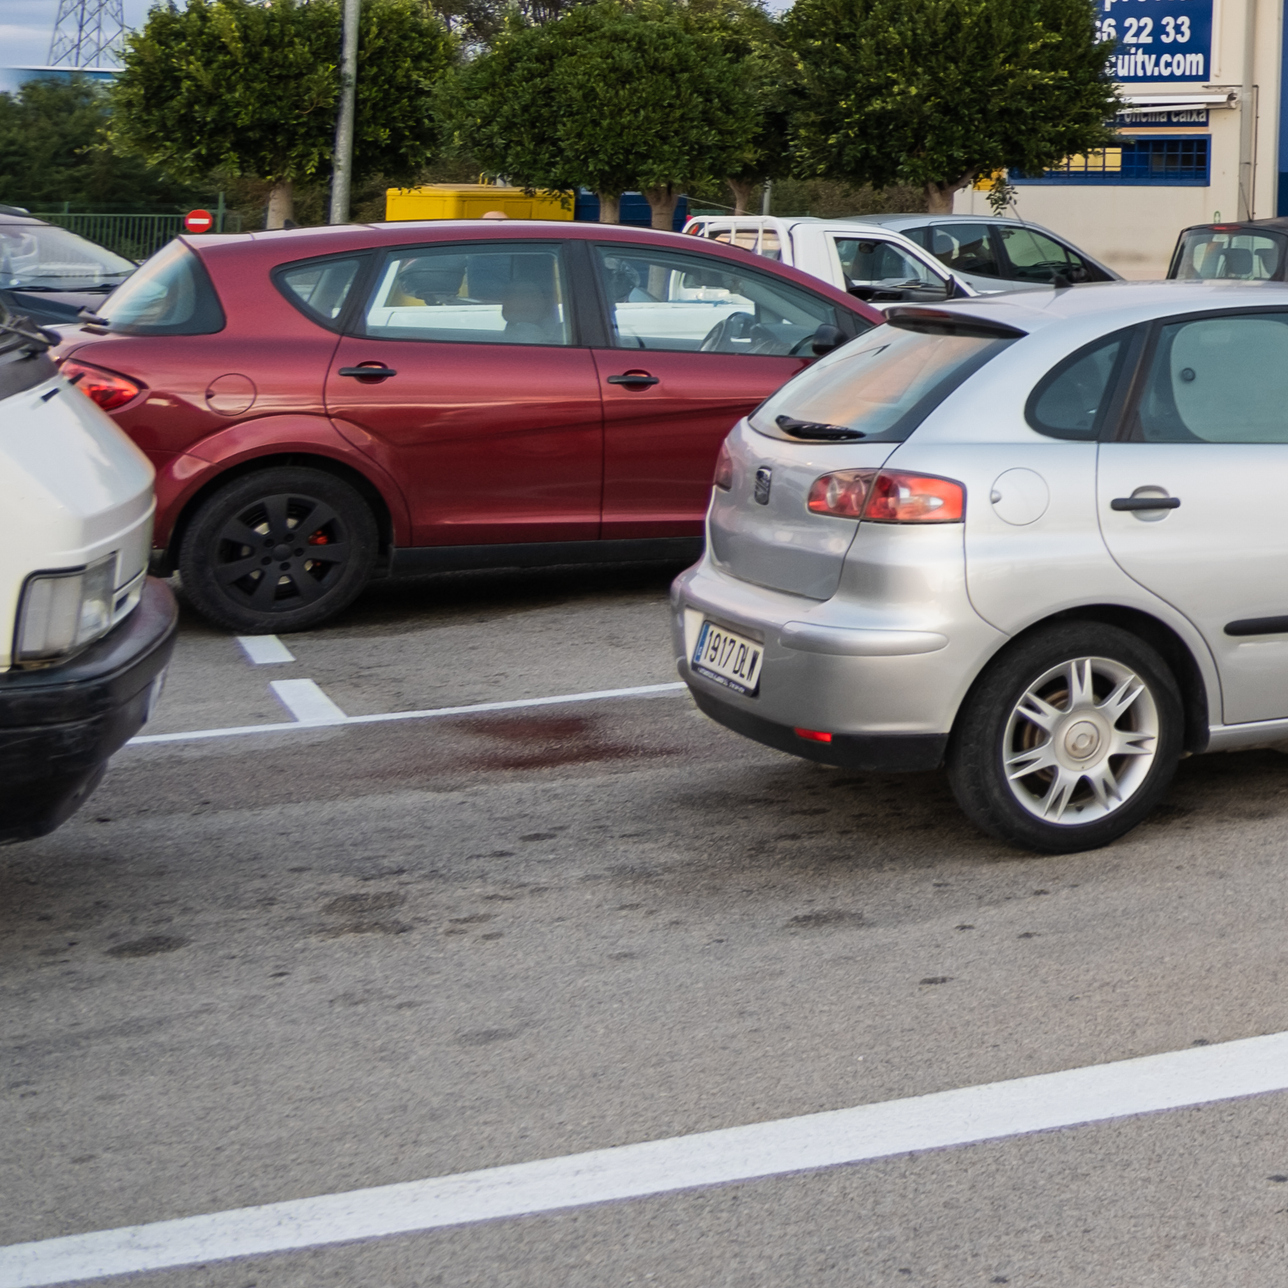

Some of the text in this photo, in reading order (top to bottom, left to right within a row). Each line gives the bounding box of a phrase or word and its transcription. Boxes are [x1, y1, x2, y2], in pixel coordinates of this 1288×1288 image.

[1122, 17, 1153, 44] 22
[1160, 16, 1191, 43] 33
[704, 630, 737, 669] 1917
